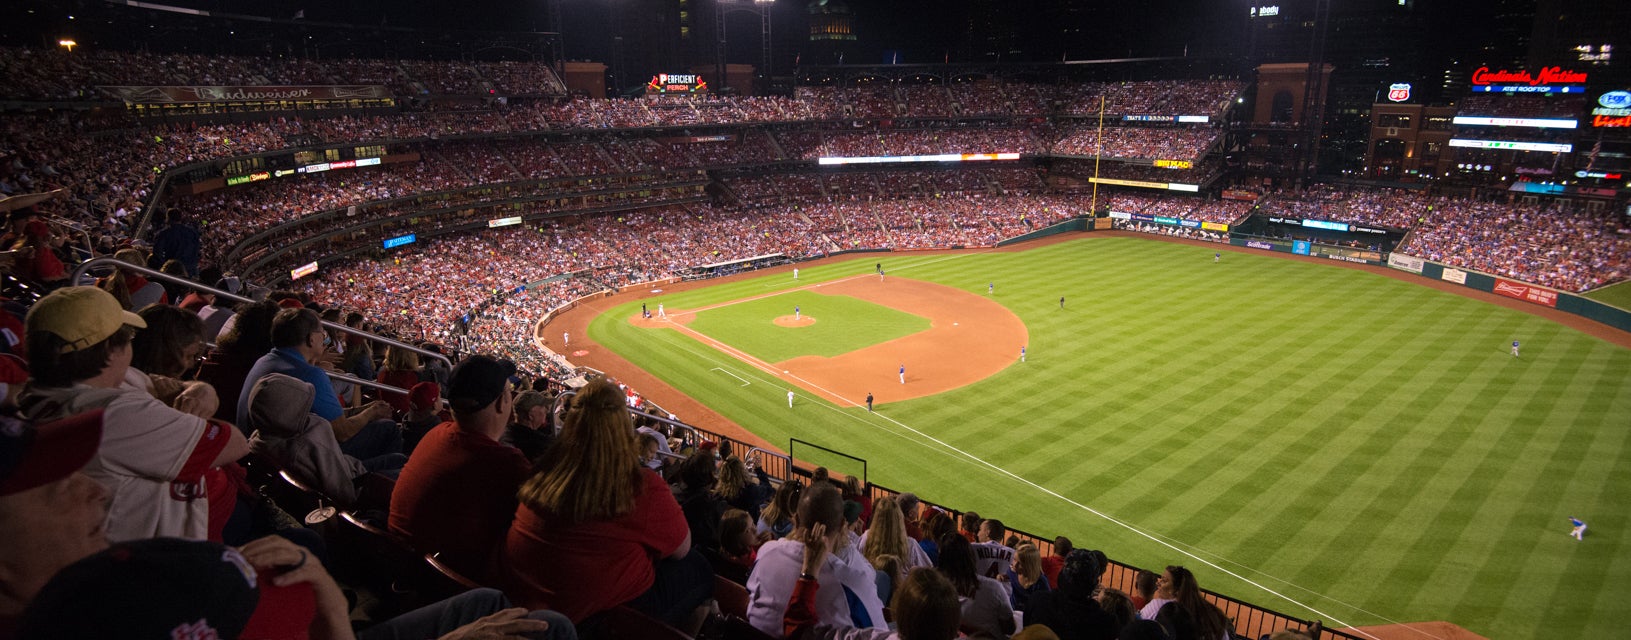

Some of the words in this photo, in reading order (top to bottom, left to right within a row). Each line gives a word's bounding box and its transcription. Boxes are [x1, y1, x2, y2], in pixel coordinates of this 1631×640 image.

[660, 74, 695, 84] PERFICIENT
[1472, 67, 1533, 85] Cardinals
[1530, 66, 1588, 86] Nation
[194, 87, 312, 100] Budweiser
[1391, 90, 1406, 98] 66
[1170, 161, 1189, 169] MAC
[1247, 241, 1271, 250] Scottrade
[1345, 256, 1367, 264] STADIUM
[977, 547, 1012, 562] MOLINA
